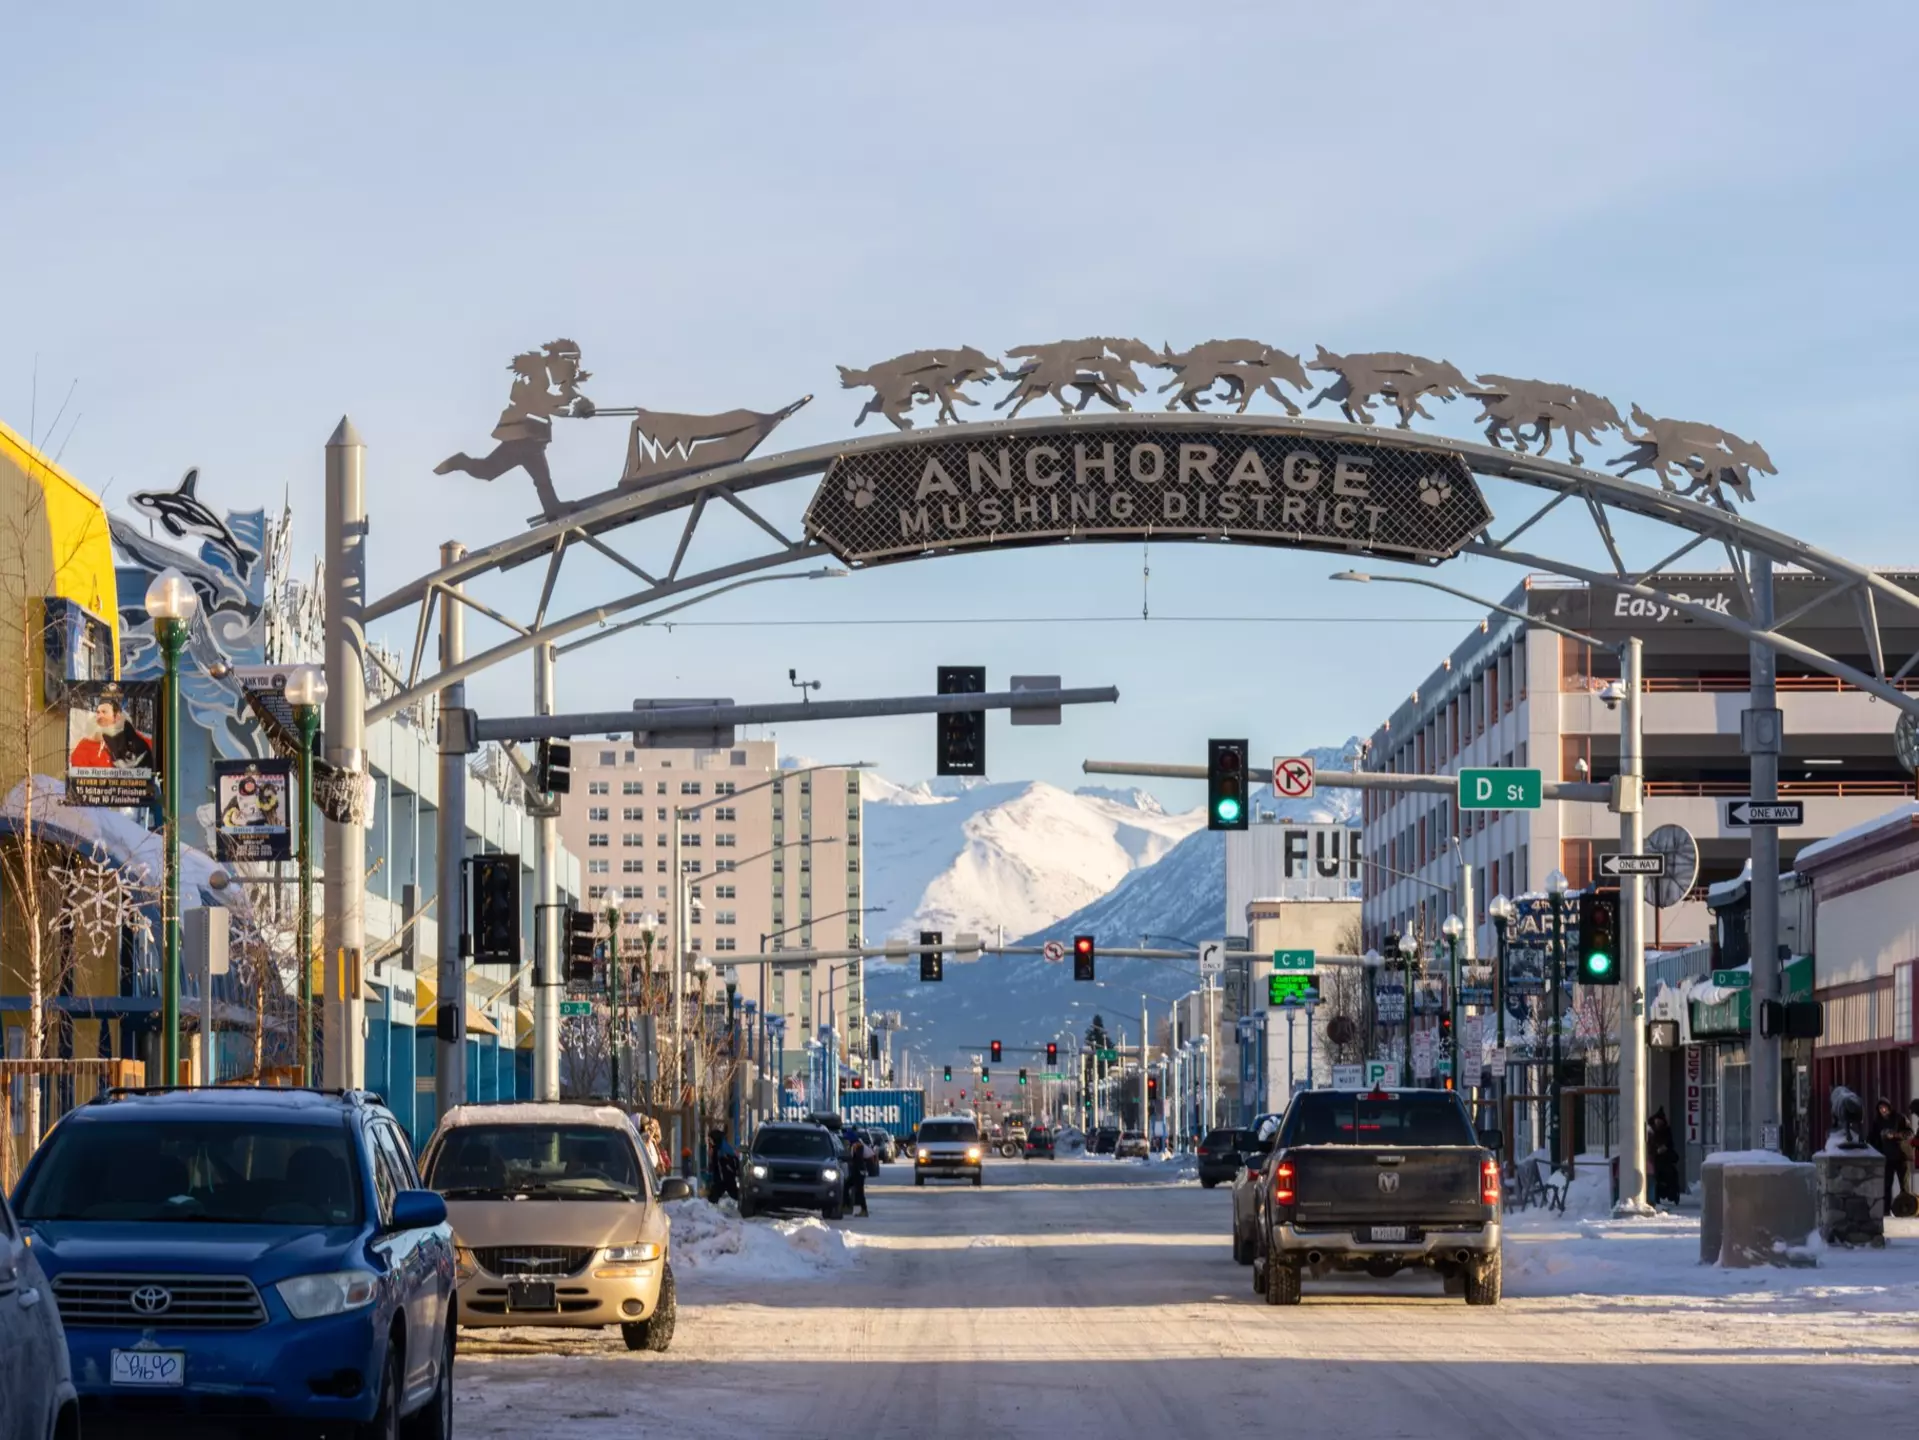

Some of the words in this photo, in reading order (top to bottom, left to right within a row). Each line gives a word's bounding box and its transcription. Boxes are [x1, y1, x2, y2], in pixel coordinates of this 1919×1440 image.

[914, 442, 1374, 500] ANCHORAGE
[901, 490, 1135, 537] MUSHING
[1163, 491, 1388, 534] DISTRICT
[76, 786, 84, 795] 15
[118, 787, 147, 796] Finishes
[1476, 777, 1493, 801] D
[1507, 784, 1524, 801] St
[111, 796, 140, 804] Finishes
[1751, 809, 1771, 818] ONE
[1775, 808, 1796, 818] WAY
[1619, 860, 1636, 869] ONE
[1639, 860, 1657, 869] WAY
[1282, 954, 1291, 966] C
[1719, 975, 1726, 984] D
[1371, 1064, 1385, 1083] P
[1687, 1086, 1700, 1141] DELI
